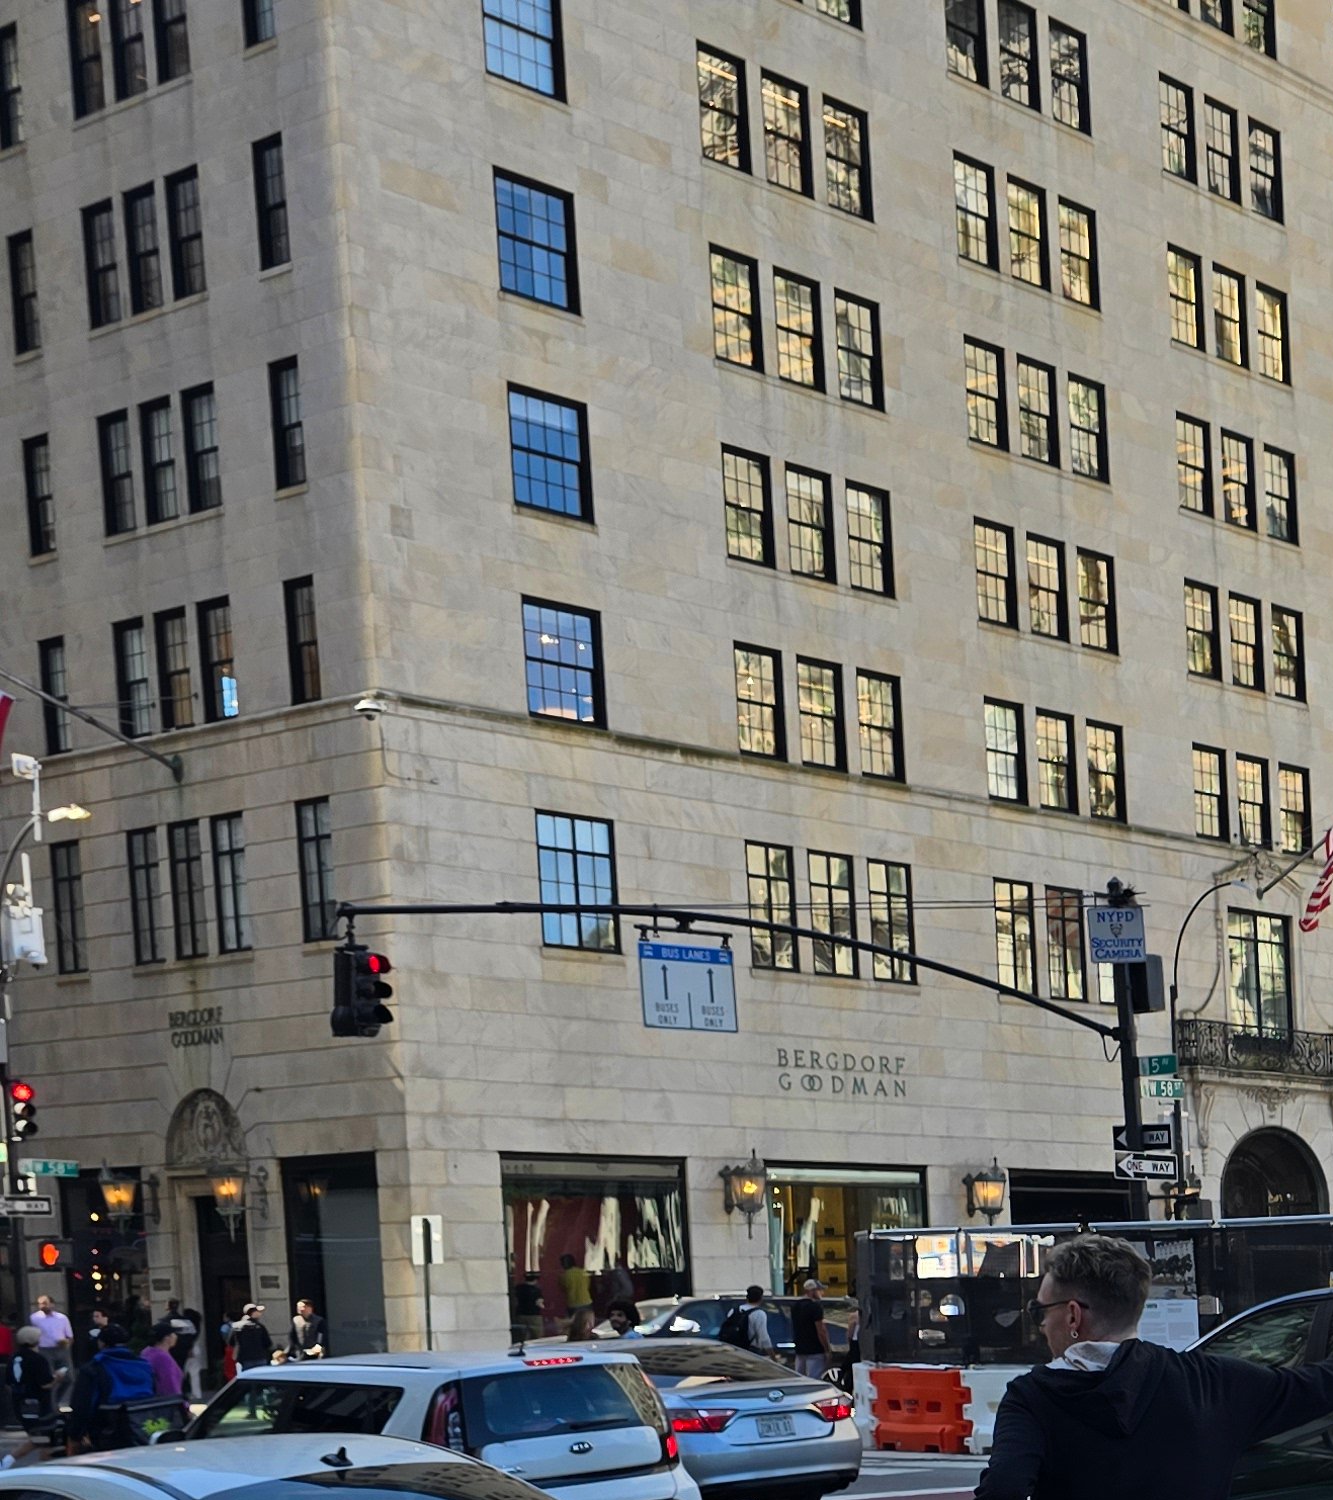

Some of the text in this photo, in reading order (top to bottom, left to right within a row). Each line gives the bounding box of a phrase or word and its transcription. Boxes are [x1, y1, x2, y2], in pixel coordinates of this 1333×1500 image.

[1097, 911, 1134, 923] NYPD
[1091, 937, 1143, 948] SECURITY
[661, 947, 711, 960] BUS LANES
[1095, 949, 1142, 959] CAMERA
[655, 1002, 679, 1013] BUSES
[702, 1005, 725, 1016] BUSES
[658, 1014, 678, 1024] ONLY
[704, 1018, 723, 1027] ONLY
[777, 1048, 906, 1076] BERGDORF
[1151, 1058, 1160, 1073] 5
[778, 1072, 907, 1097] GOODMAN
[1149, 1081, 1157, 1096] W
[1160, 1081, 1173, 1097] 58
[1148, 1132, 1166, 1143] WAY
[1126, 1160, 1171, 1173] ONE WAY
